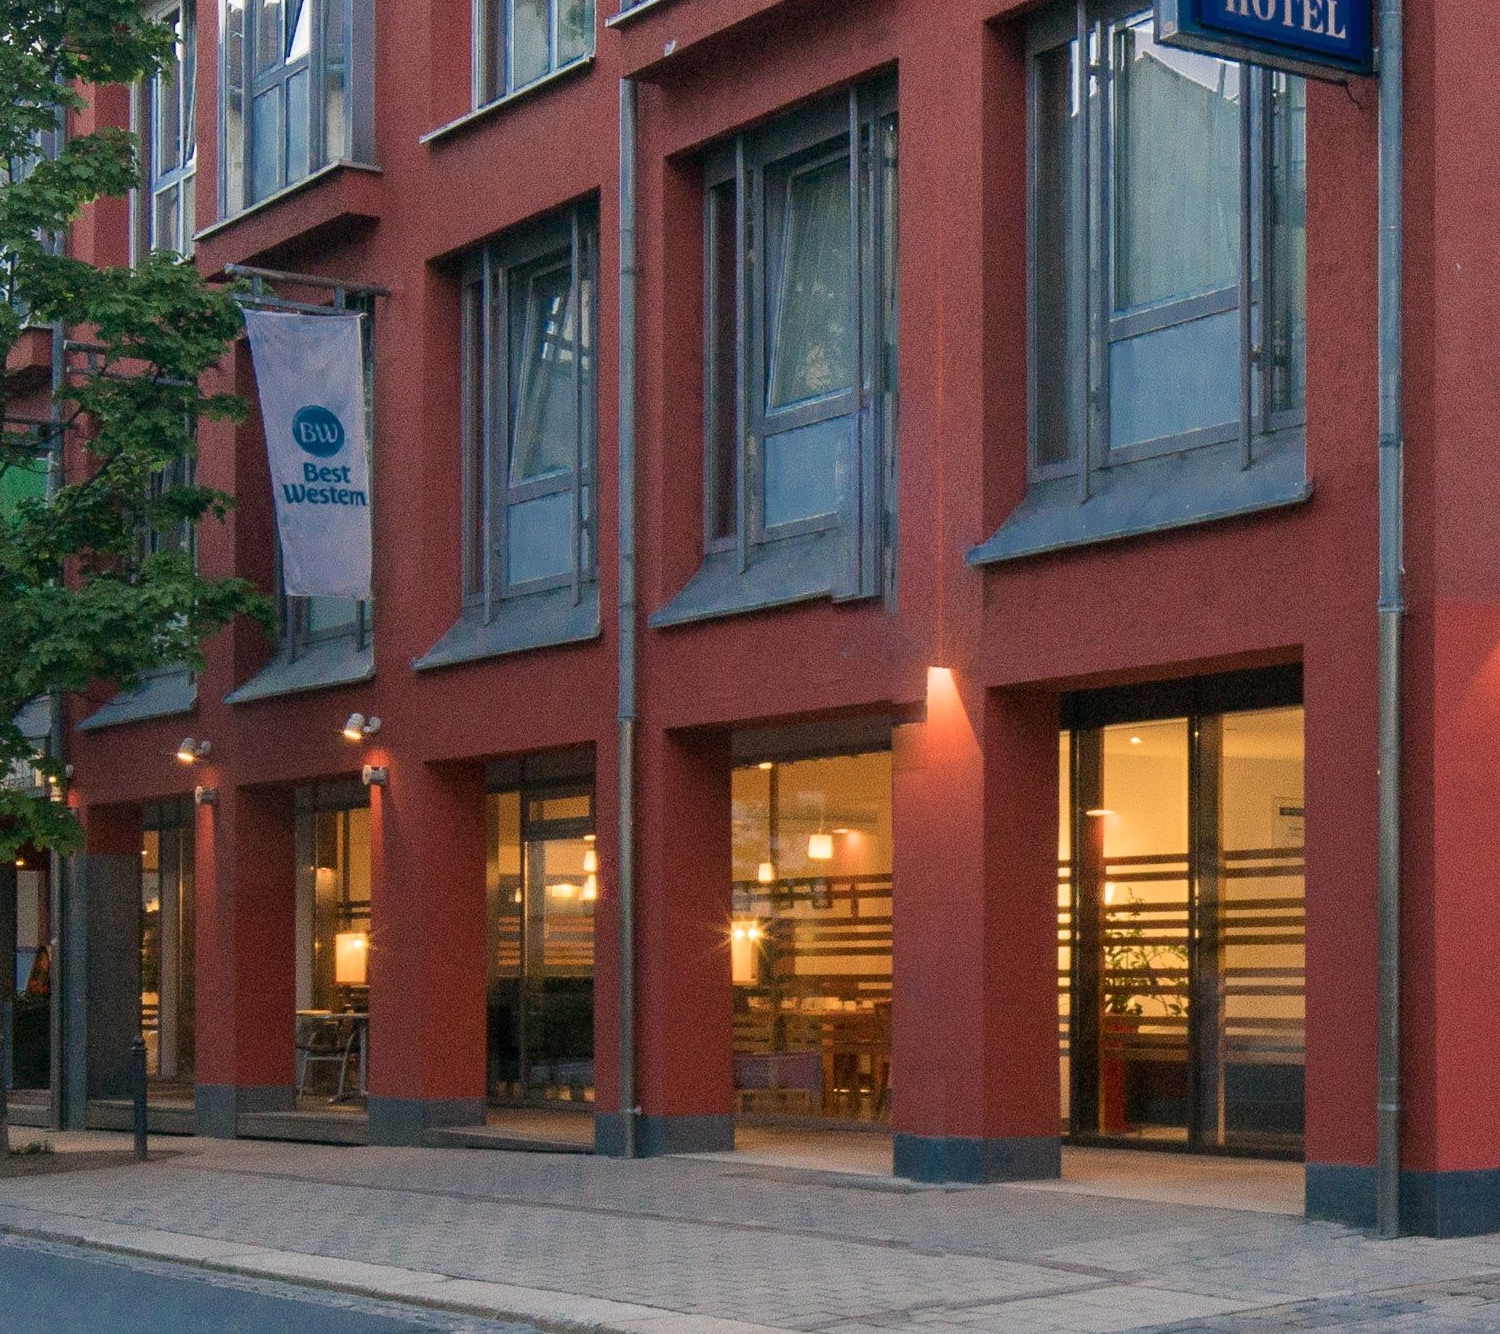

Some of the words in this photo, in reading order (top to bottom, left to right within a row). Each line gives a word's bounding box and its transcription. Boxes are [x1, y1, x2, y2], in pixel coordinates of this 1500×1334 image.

[300, 421, 339, 443] BW
[303, 462, 351, 484] Best
[282, 483, 367, 507] Western
